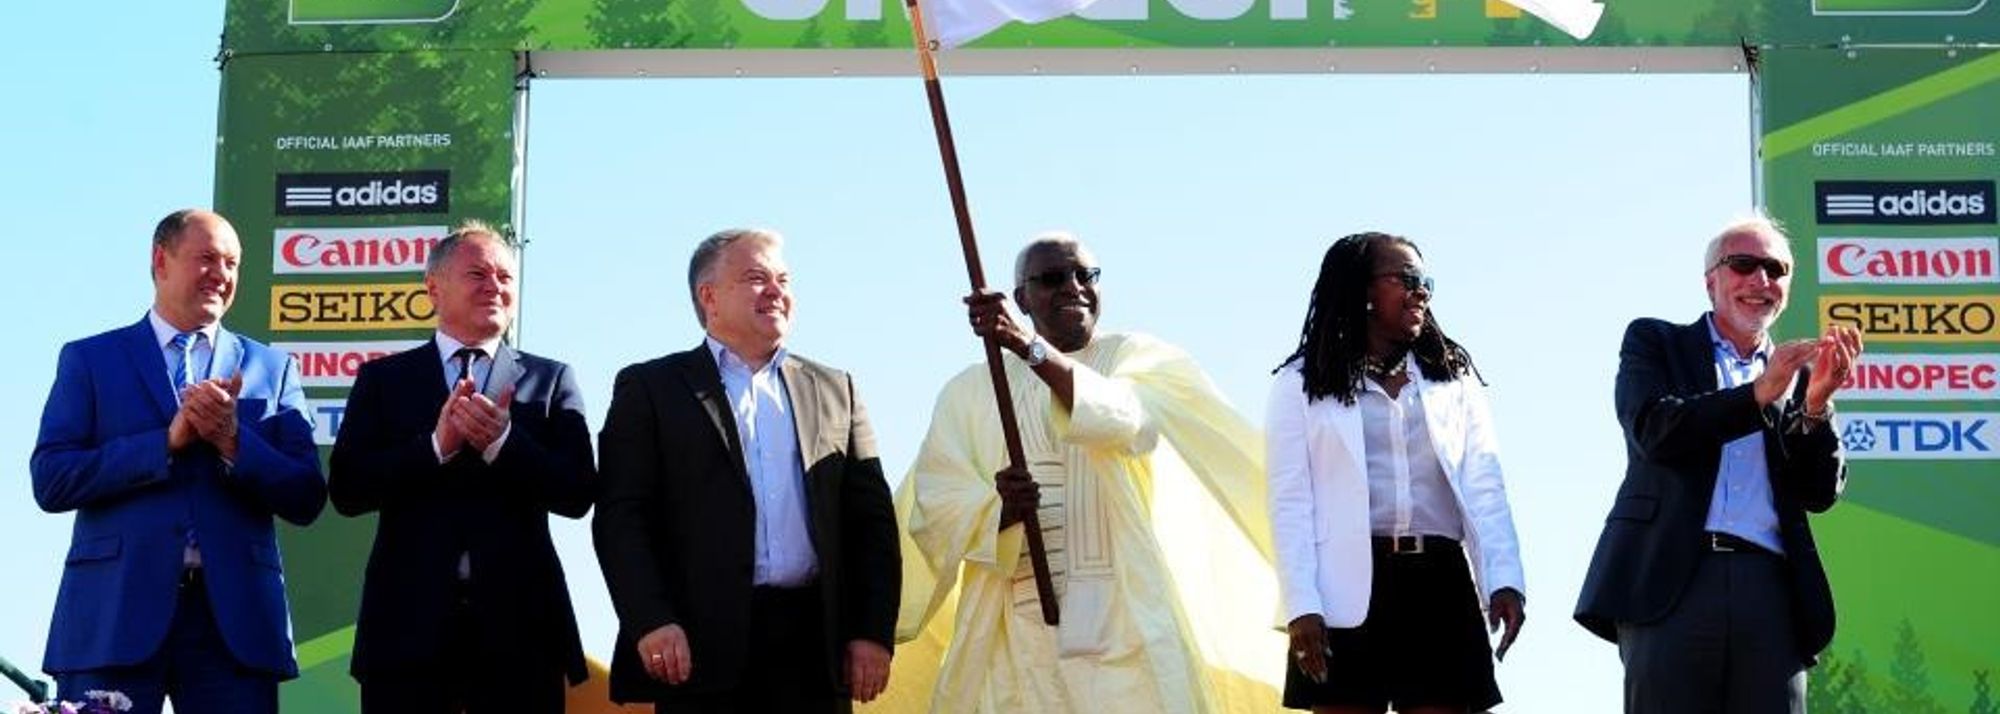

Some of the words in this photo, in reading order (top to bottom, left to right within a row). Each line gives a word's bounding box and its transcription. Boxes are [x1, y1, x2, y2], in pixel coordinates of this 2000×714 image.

[276, 136, 338, 150] OFFICIAL
[342, 135, 376, 149] IAAF
[377, 133, 451, 148] PARTNERS
[1812, 143, 1878, 157] OFFICIAL
[1881, 143, 1914, 156] IAAF
[1918, 142, 1995, 156] PARTNERS
[336, 180, 438, 206] adidas
[1878, 189, 1985, 216] adidas
[1827, 244, 1992, 277] Canon
[1828, 302, 1996, 335] SEIKO
[1875, 419, 1992, 451] TDK
